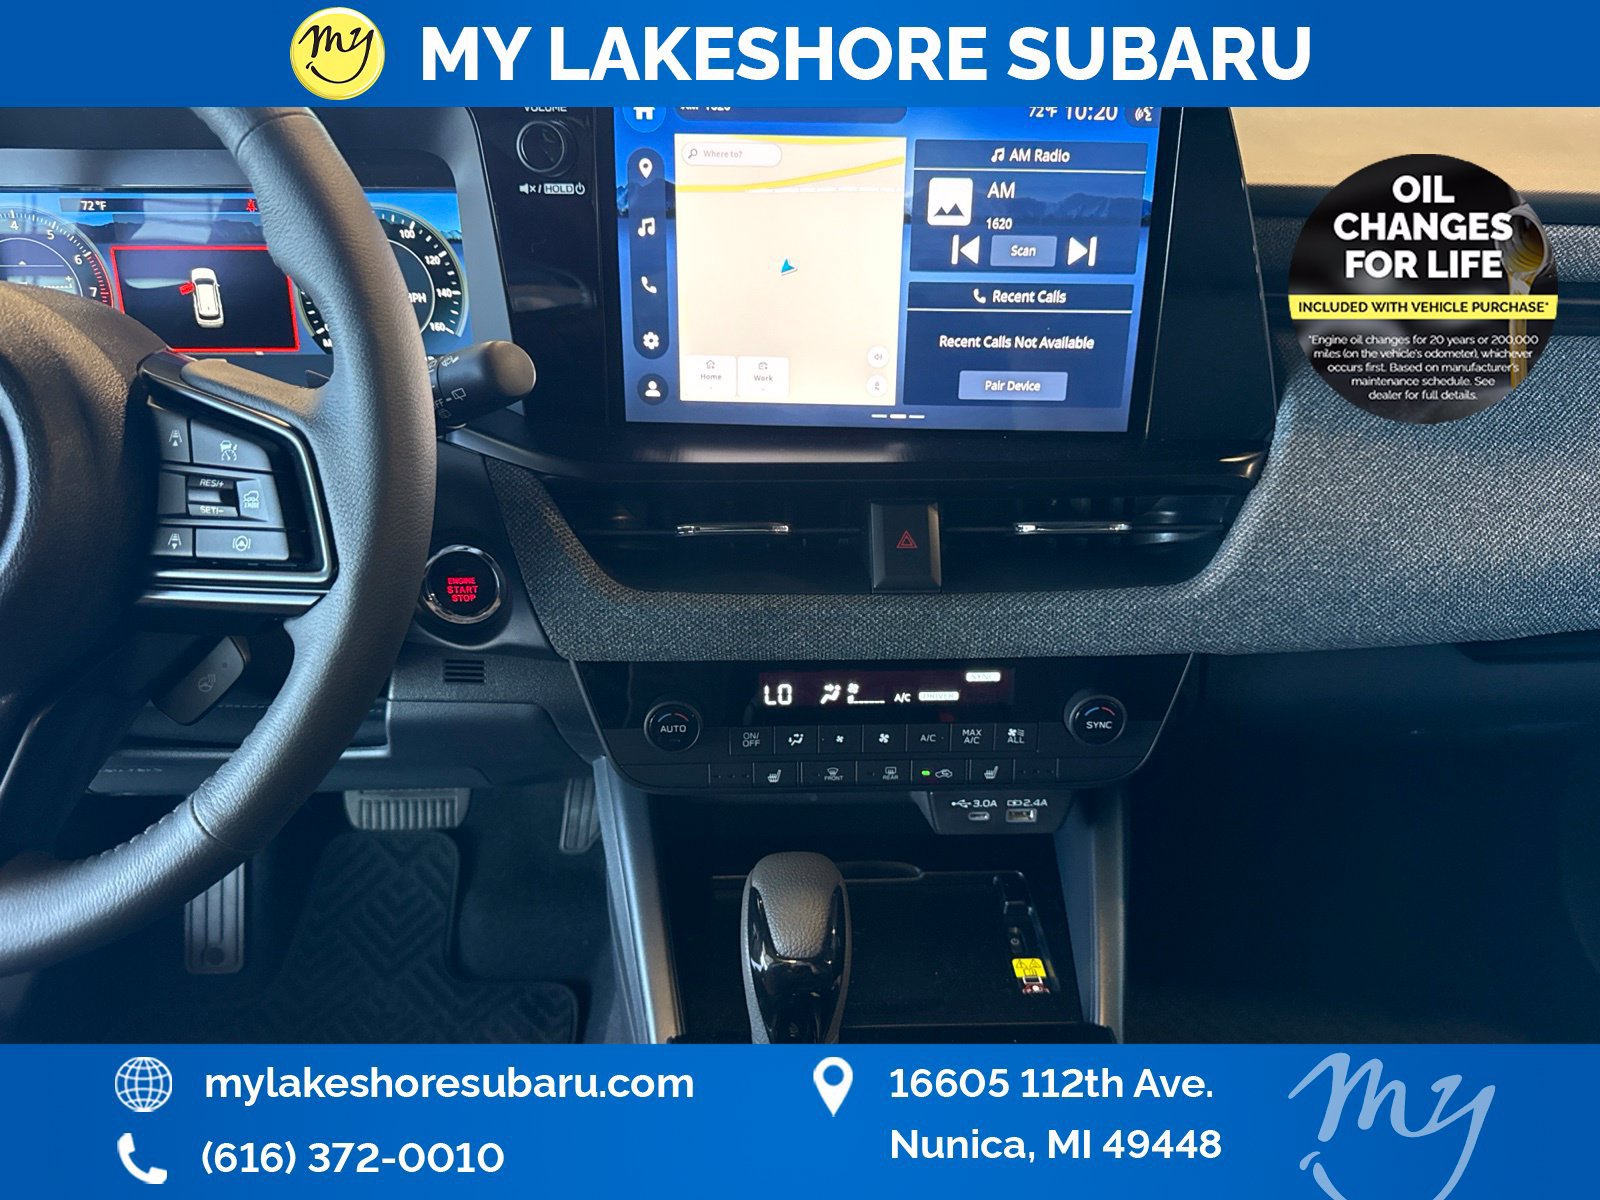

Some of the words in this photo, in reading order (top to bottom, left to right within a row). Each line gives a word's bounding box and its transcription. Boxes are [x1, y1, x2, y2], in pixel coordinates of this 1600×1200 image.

[1065, 107, 1118, 121] 10:20
[703, 149, 729, 158] Where
[731, 150, 743, 158] to?
[1009, 149, 1031, 162] AM
[1034, 149, 1070, 163] Radio
[544, 184, 575, 195] HOLD
[987, 181, 1016, 199] AM
[10, 221, 19, 231] 4
[986, 217, 1013, 230] 1620
[47, 229, 55, 240] 5
[399, 229, 416, 239] 100
[1010, 245, 1037, 257] Scan
[74, 254, 83, 265] 6
[424, 255, 441, 266] 120
[89, 286, 98, 298] 7
[436, 288, 452, 298] 140
[992, 290, 1035, 304] Recent
[1037, 290, 1067, 304] Calls
[430, 322, 446, 332] 160
[939, 335, 981, 349] Recent
[983, 335, 1012, 349] Calls
[1014, 336, 1037, 349] Not
[1039, 336, 1095, 350] Available
[984, 379, 1005, 392] Pair
[1007, 379, 1041, 393] Device
[446, 585, 478, 594] START
[451, 594, 476, 602] STOP
[763, 683, 793, 706] LO
[893, 692, 912, 703] A/C
[660, 724, 687, 733] AUTO
[1086, 721, 1113, 729] SYNC
[742, 732, 760, 740] ON/
[920, 734, 936, 742] A/C
[962, 729, 982, 737] MAX
[742, 739, 760, 747] OFF
[963, 736, 980, 744] A/C
[1007, 736, 1025, 744] ALL
[1023, 799, 1048, 807] 2.4A
